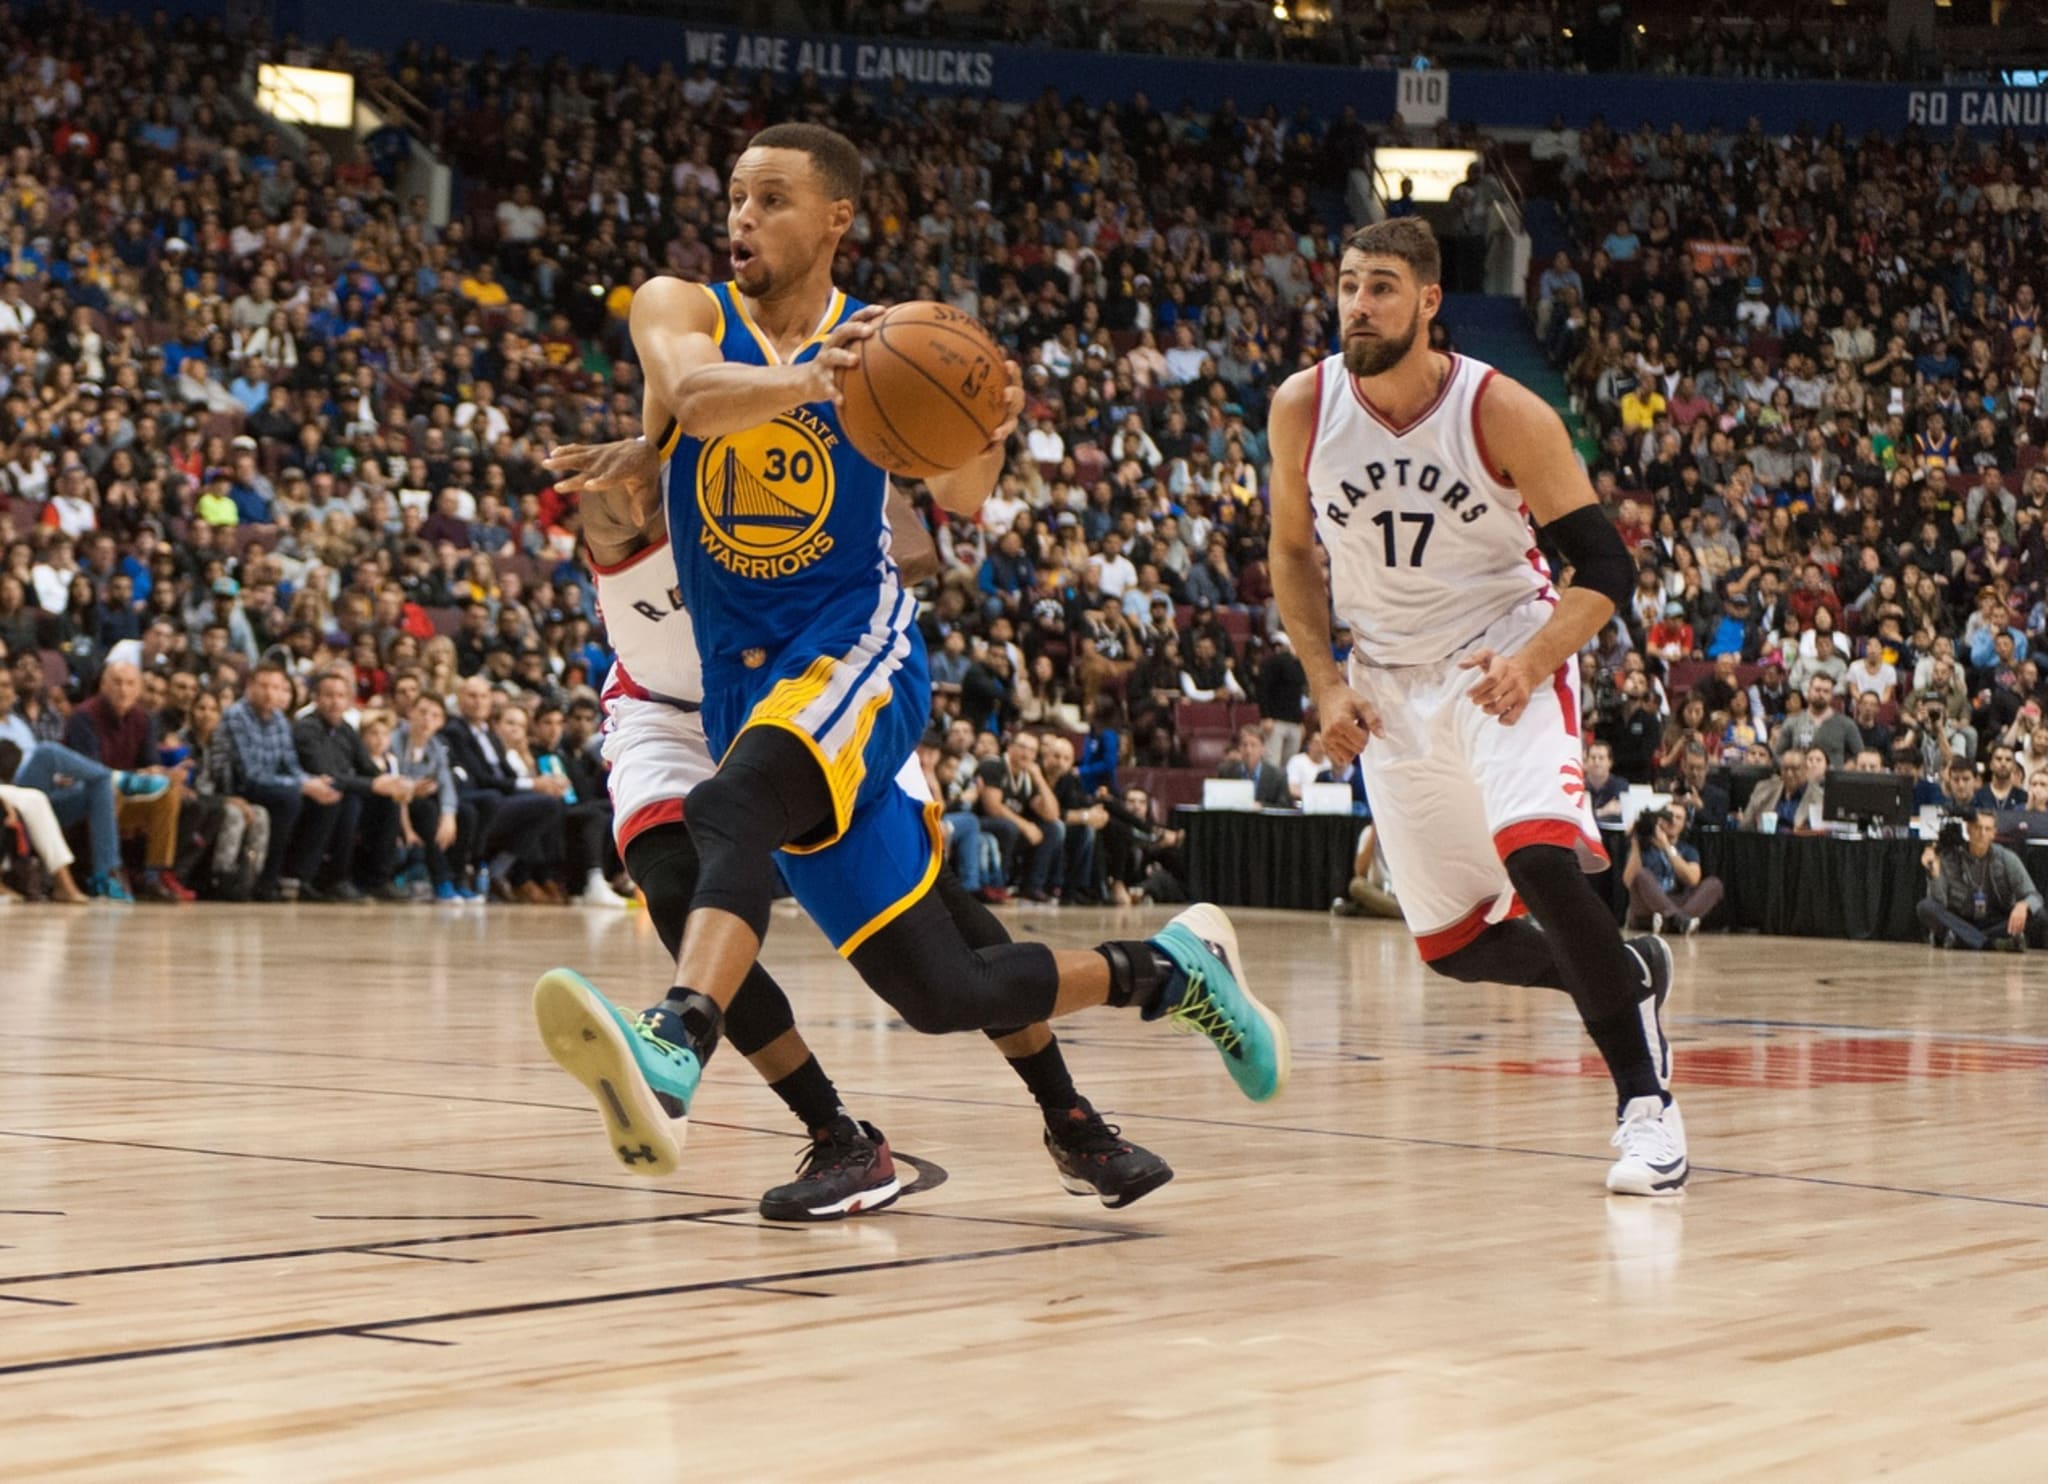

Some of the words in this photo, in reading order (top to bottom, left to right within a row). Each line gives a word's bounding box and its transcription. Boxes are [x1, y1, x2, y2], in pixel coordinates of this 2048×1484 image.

[685, 30, 727, 67] WE
[735, 34, 789, 72] ARE
[797, 40, 846, 77] ALL
[856, 45, 993, 88] CANUCKS
[1405, 75, 1441, 106] 110
[1908, 91, 1948, 126] GO
[1960, 91, 2048, 126] CANU
[763, 448, 814, 484] 30
[1327, 458, 1488, 527] RAPTORS
[700, 526, 834, 579] WARRIORS
[1371, 510, 1435, 567] 17
